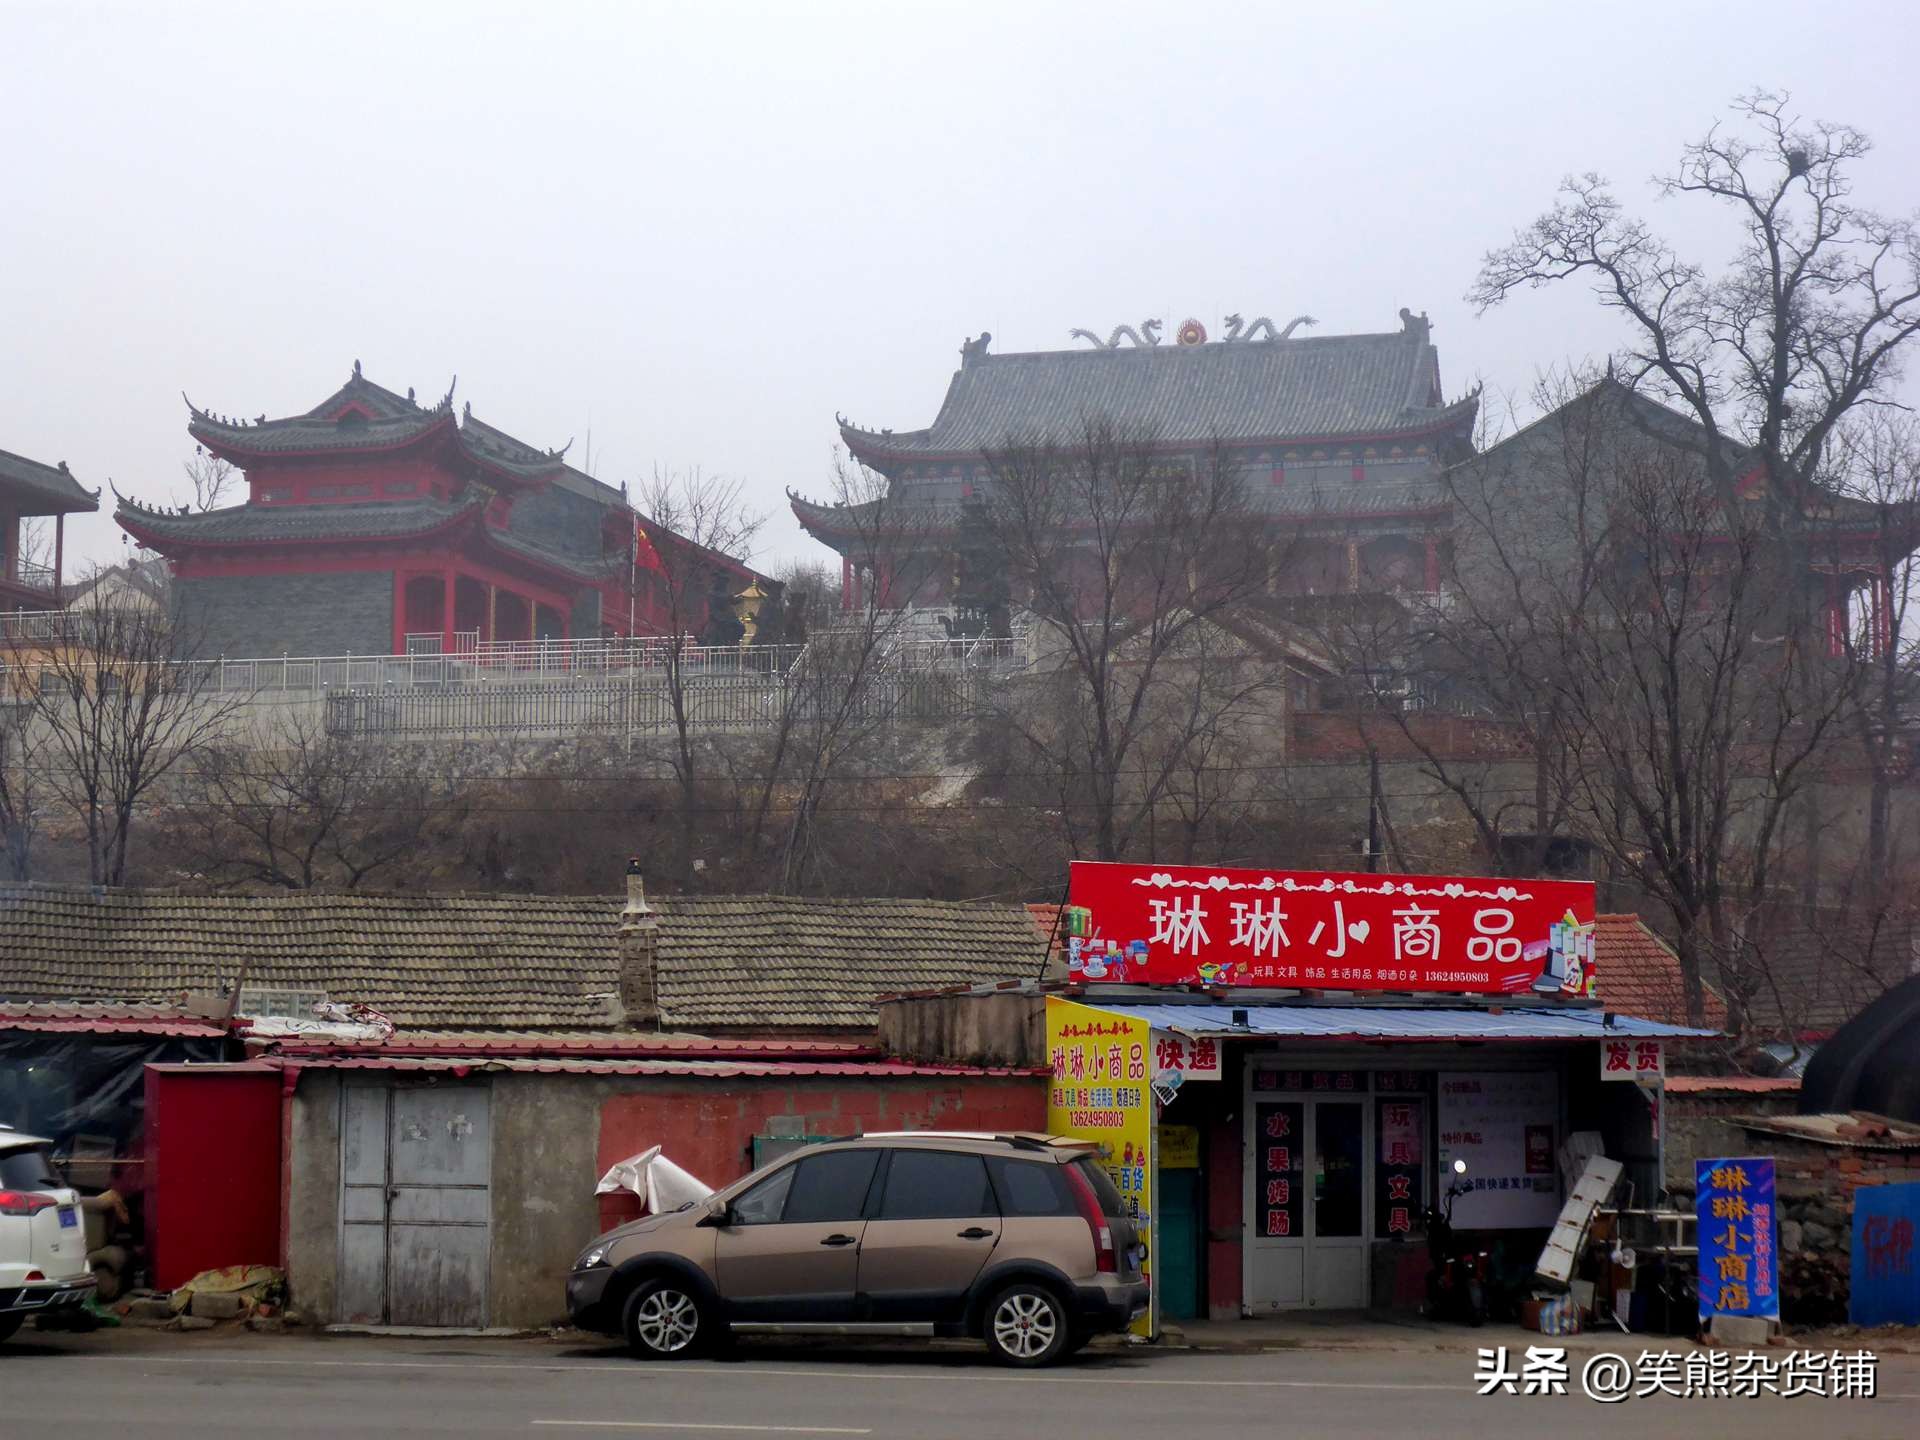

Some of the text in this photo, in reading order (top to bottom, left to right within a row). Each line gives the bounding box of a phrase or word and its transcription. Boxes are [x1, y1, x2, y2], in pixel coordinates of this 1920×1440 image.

[1149, 895, 1523, 962] 琳琳小商品
[1253, 965, 1489, 983] 玩具 文具 饰品 生活用品 烟酒日杂 13624950803
[1051, 1042, 1145, 1082] 琳琳小商品
[1156, 1038, 1218, 1071] 快递
[1605, 1041, 1660, 1073] 发货
[1065, 1088, 1076, 1107] 文具
[1090, 1087, 1113, 1107] 生活用品
[1116, 1087, 1141, 1108] 烟酒日杂
[1069, 1110, 1124, 1128] 13624950803
[1266, 1111, 1291, 1236] 水果烤肠
[1387, 1102, 1412, 1234] 玩具文具
[1710, 1165, 1753, 1313] 琳琳小商店
